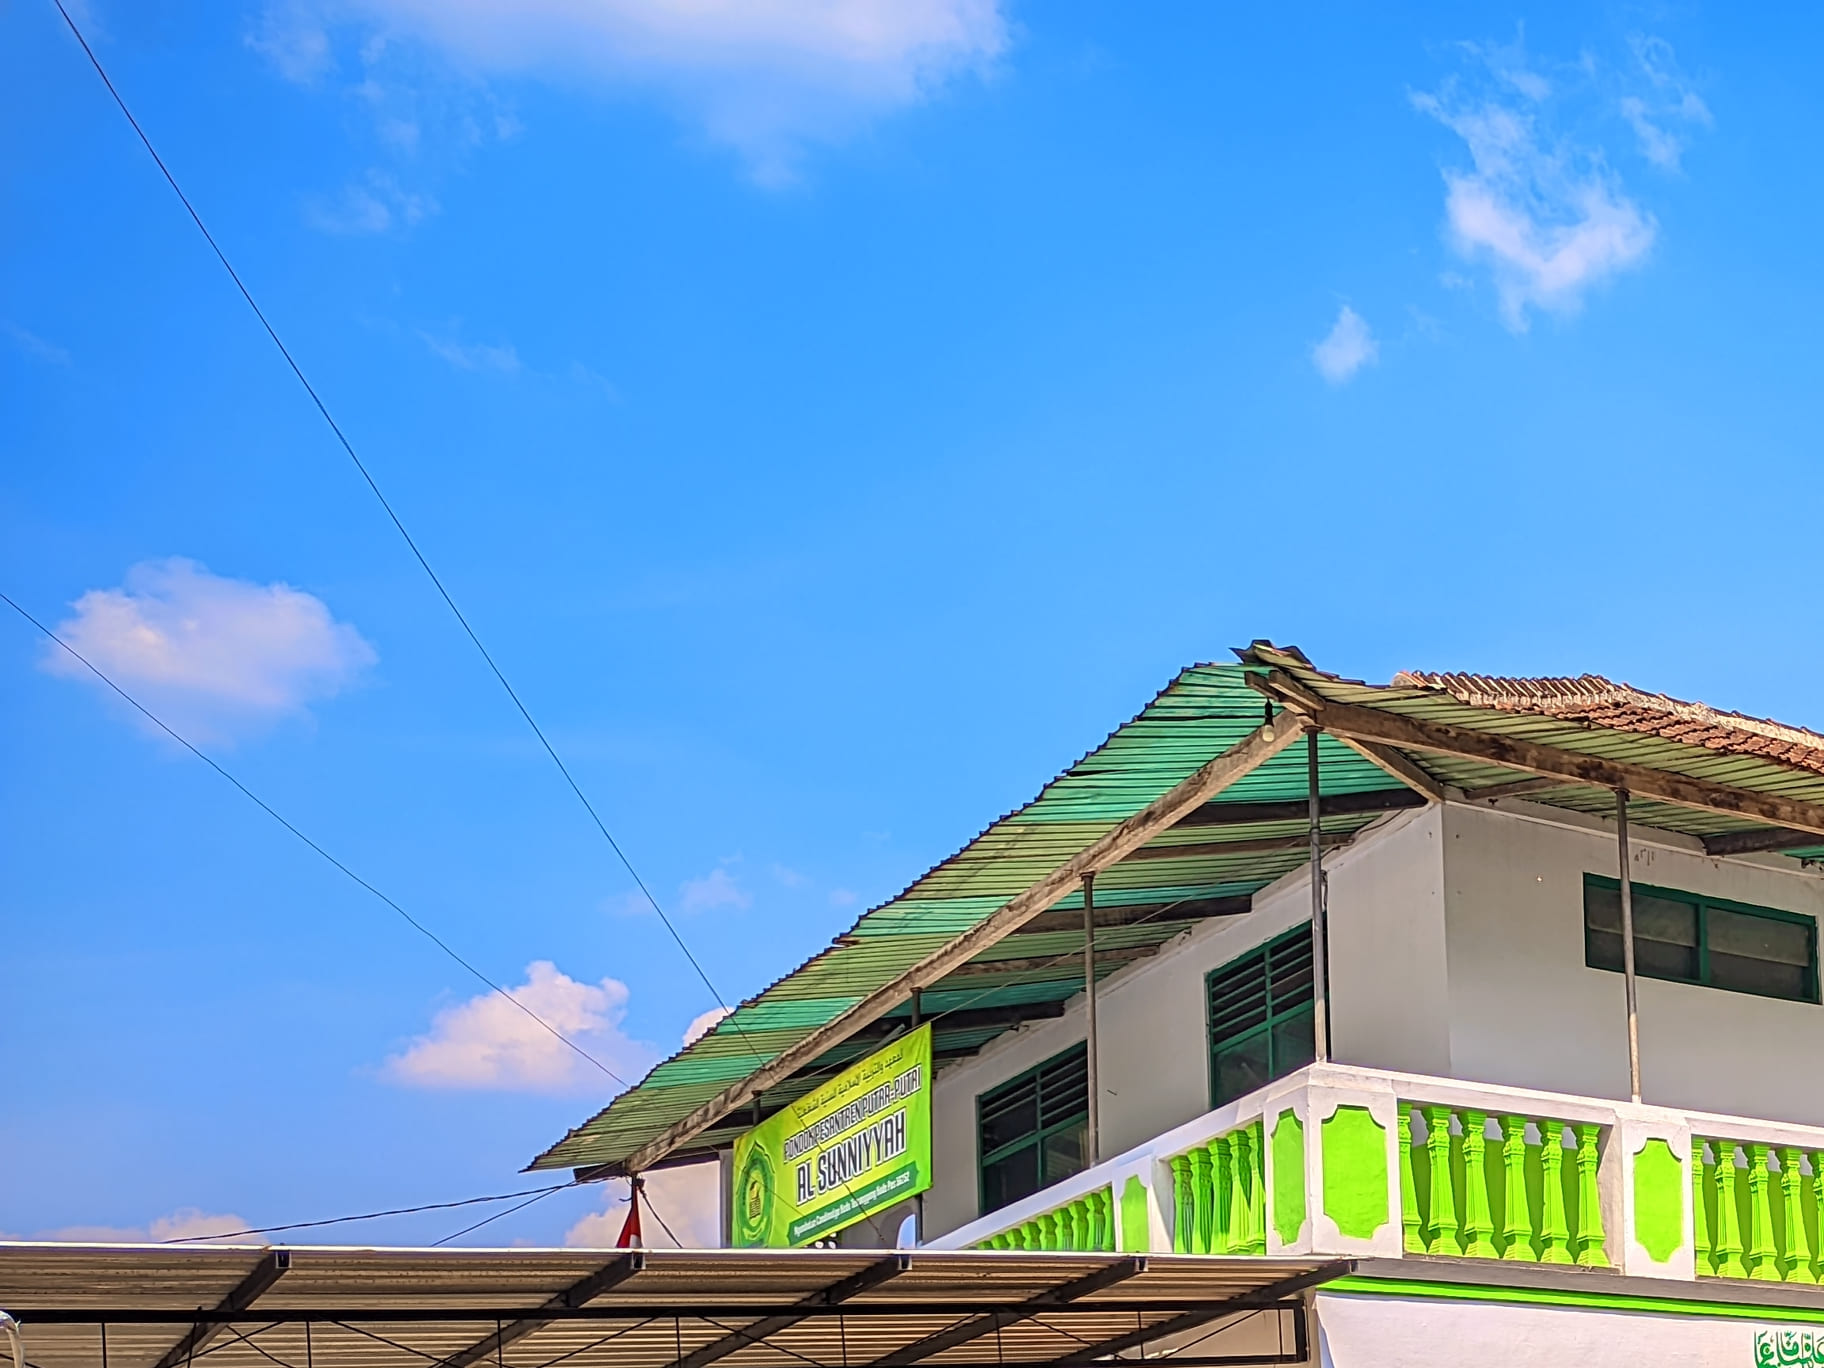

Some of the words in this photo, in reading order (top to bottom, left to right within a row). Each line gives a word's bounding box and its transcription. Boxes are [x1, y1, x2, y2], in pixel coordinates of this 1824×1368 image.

[784, 1128, 816, 1164] PONDOK
[814, 1101, 864, 1143] PESANTREN
[797, 1159, 816, 1206] AL
[818, 1108, 906, 1194] SUNNIYYAH
